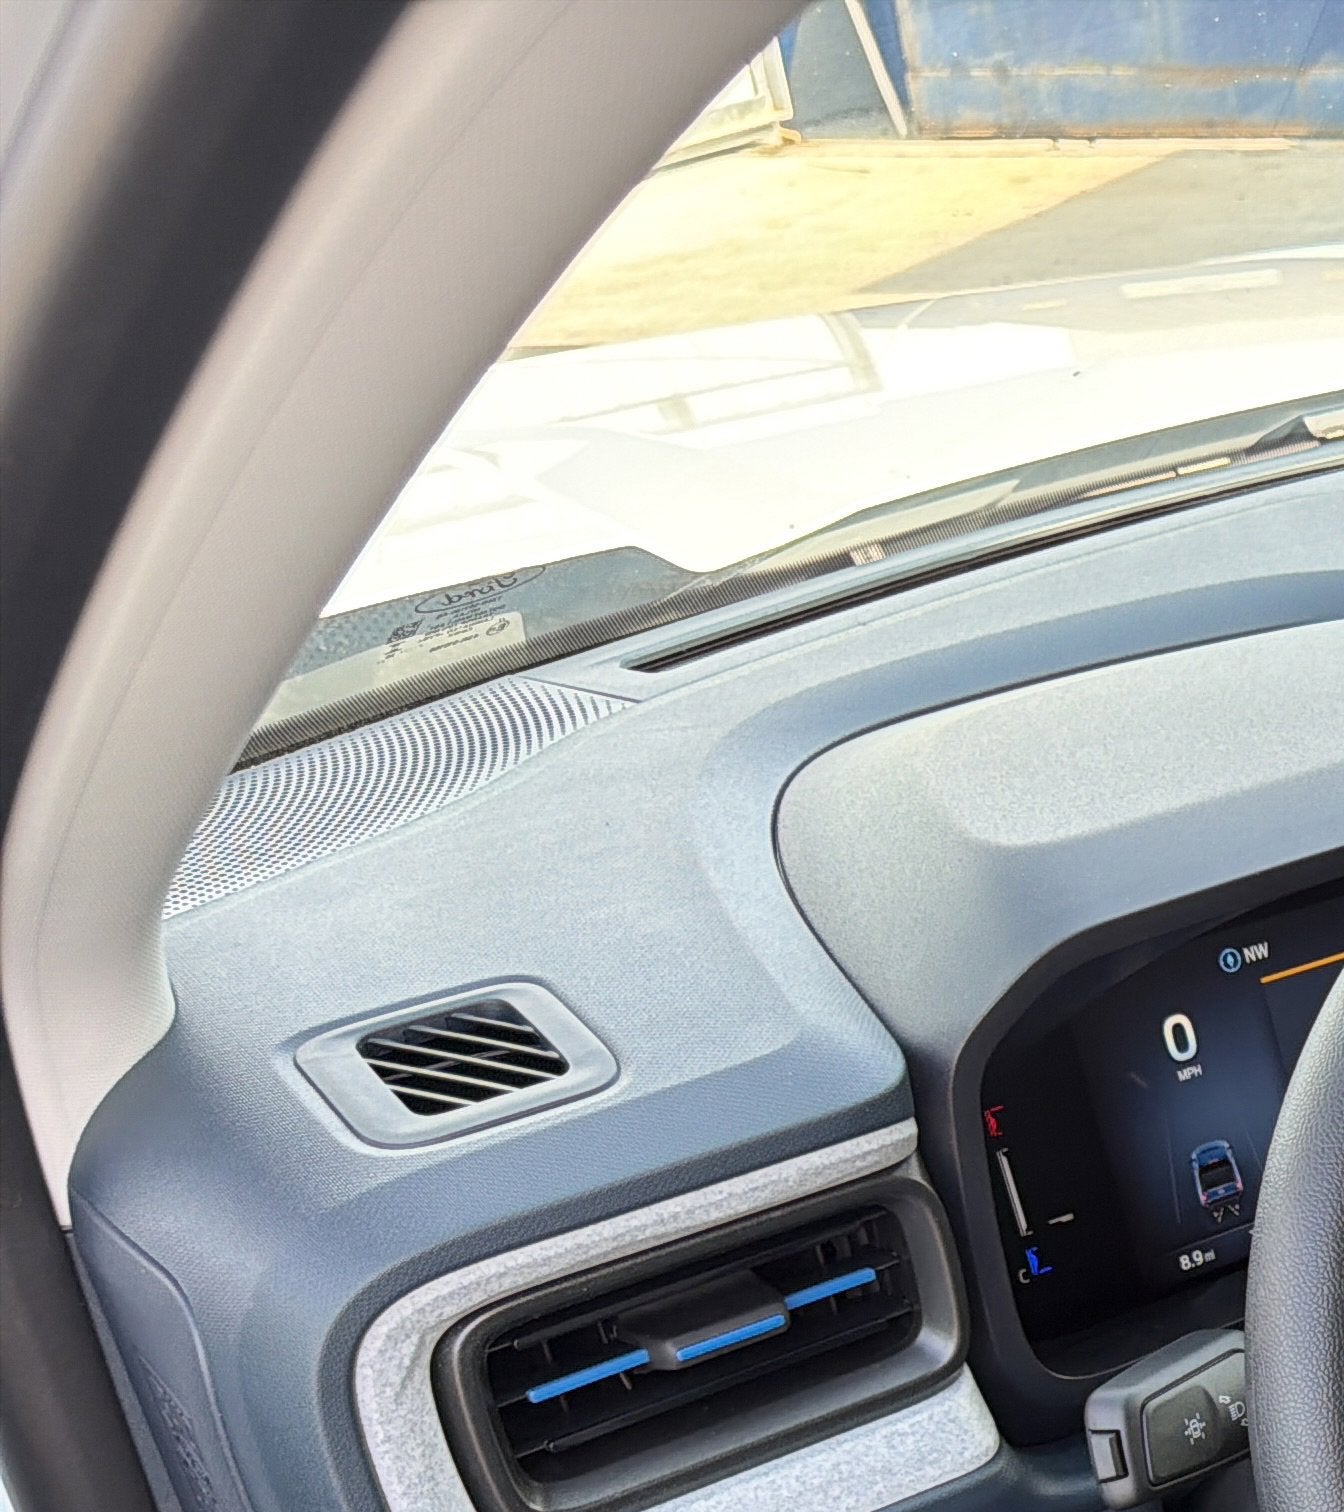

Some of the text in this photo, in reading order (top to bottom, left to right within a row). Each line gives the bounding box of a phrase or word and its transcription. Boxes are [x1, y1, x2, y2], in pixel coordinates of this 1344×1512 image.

[1242, 941, 1270, 964] NW
[1162, 1012, 1198, 1062] 0
[1177, 1064, 1203, 1083] MPH
[1178, 1249, 1205, 1272] 8.9
[1018, 1268, 1031, 1285] C
